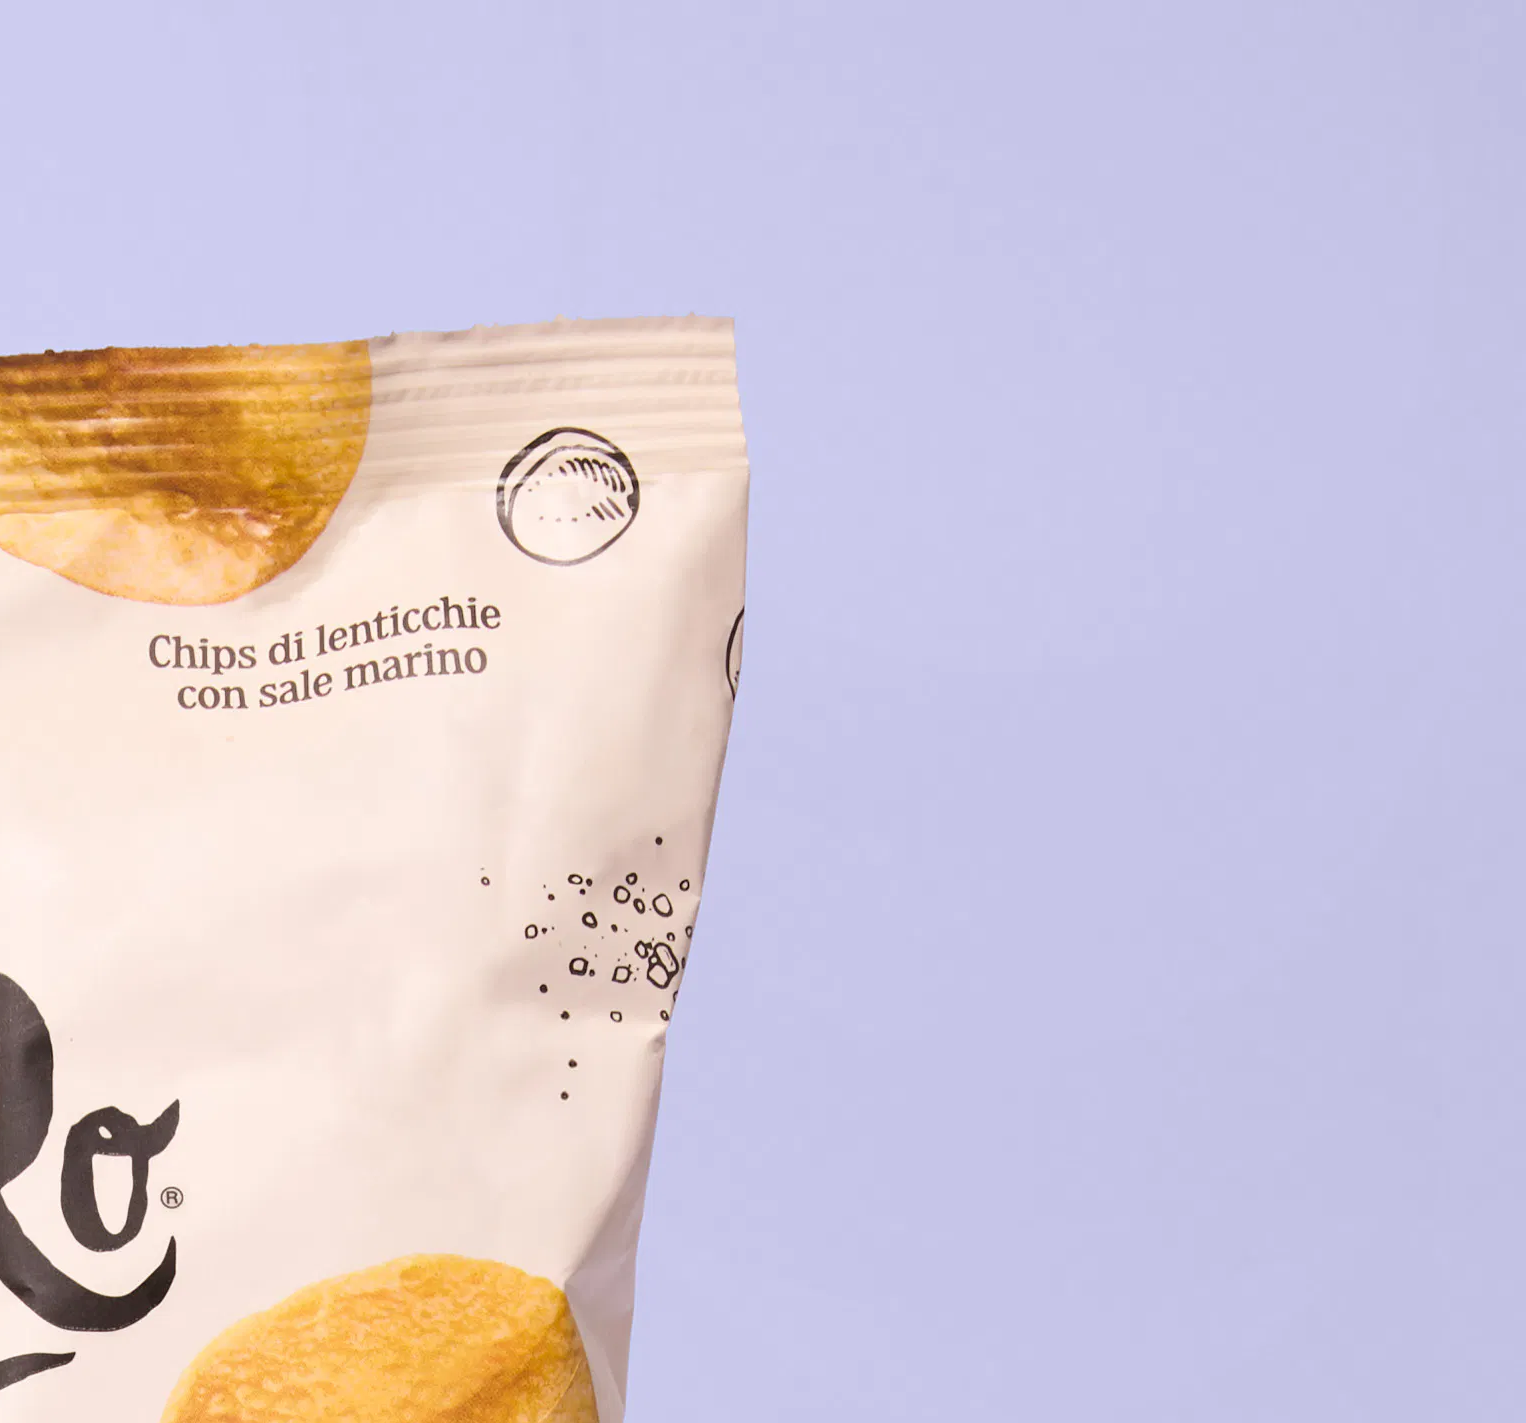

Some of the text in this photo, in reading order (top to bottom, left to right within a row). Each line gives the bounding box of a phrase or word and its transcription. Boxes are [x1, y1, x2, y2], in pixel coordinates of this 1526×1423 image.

[149, 596, 501, 676] Chips di lenticchie
[177, 642, 488, 710] con sale marino
